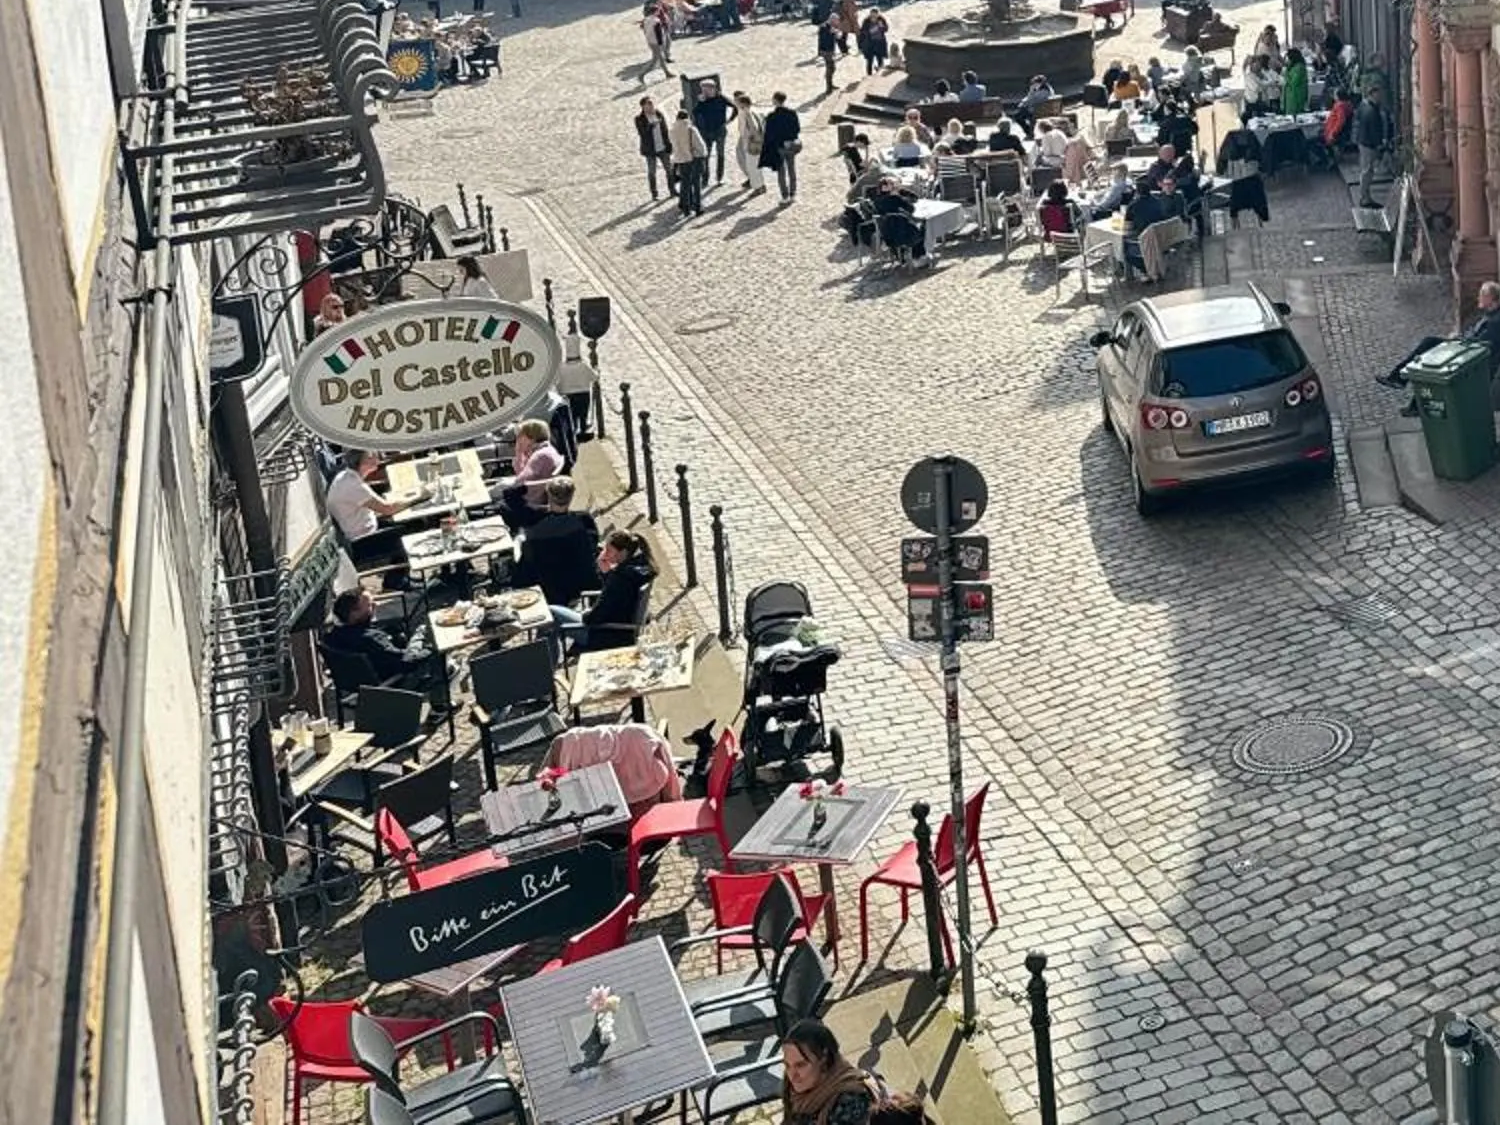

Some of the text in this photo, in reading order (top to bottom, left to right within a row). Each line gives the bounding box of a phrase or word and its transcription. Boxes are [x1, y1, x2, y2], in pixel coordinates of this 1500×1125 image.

[363, 315, 482, 360] HOTEL
[317, 347, 536, 407] Del Castello
[347, 382, 521, 434] HOSTARIA
[409, 864, 570, 953] Bitte ein Bit
